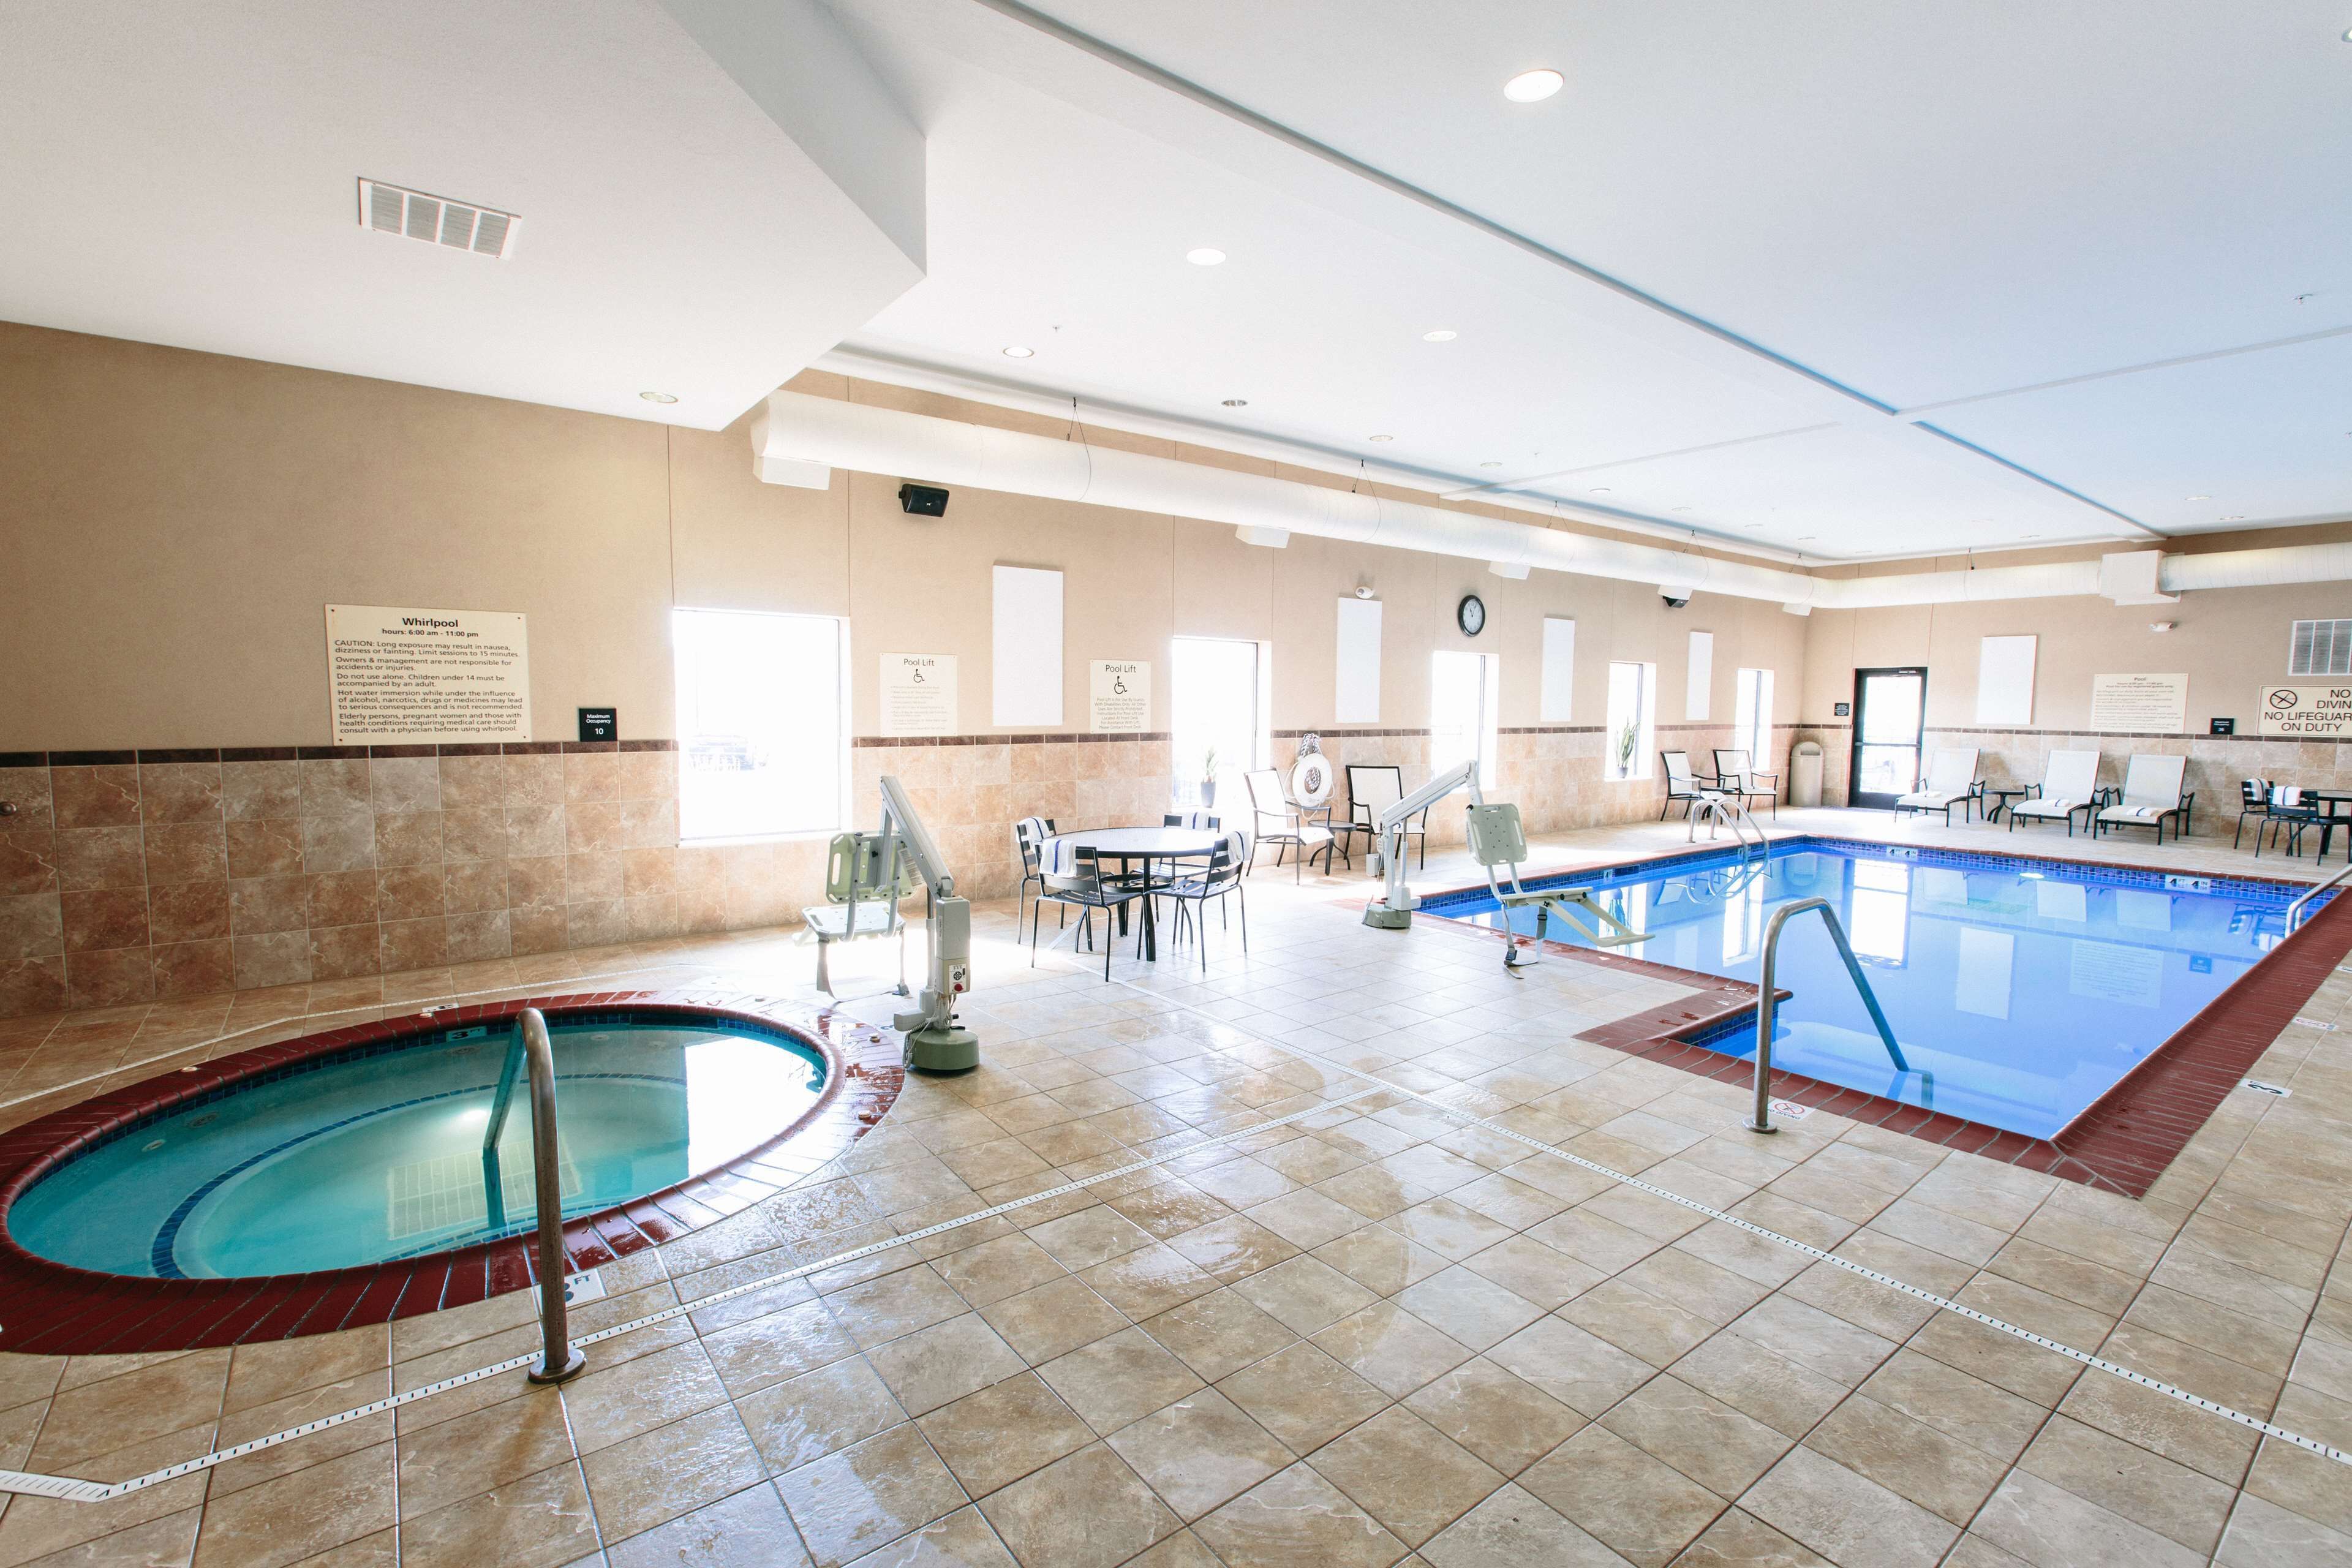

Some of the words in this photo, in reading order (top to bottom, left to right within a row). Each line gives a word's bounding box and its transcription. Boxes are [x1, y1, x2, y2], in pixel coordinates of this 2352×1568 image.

[402, 617, 458, 628] Whirlpool
[1125, 665, 1136, 673] Lift
[2330, 690, 2351, 698] NO
[2288, 712, 2352, 721] LIFEGUAR
[2305, 723, 2342, 731] DUTY
[1776, 1111, 1801, 1120] DIVING
[573, 1274, 590, 1284] FT
